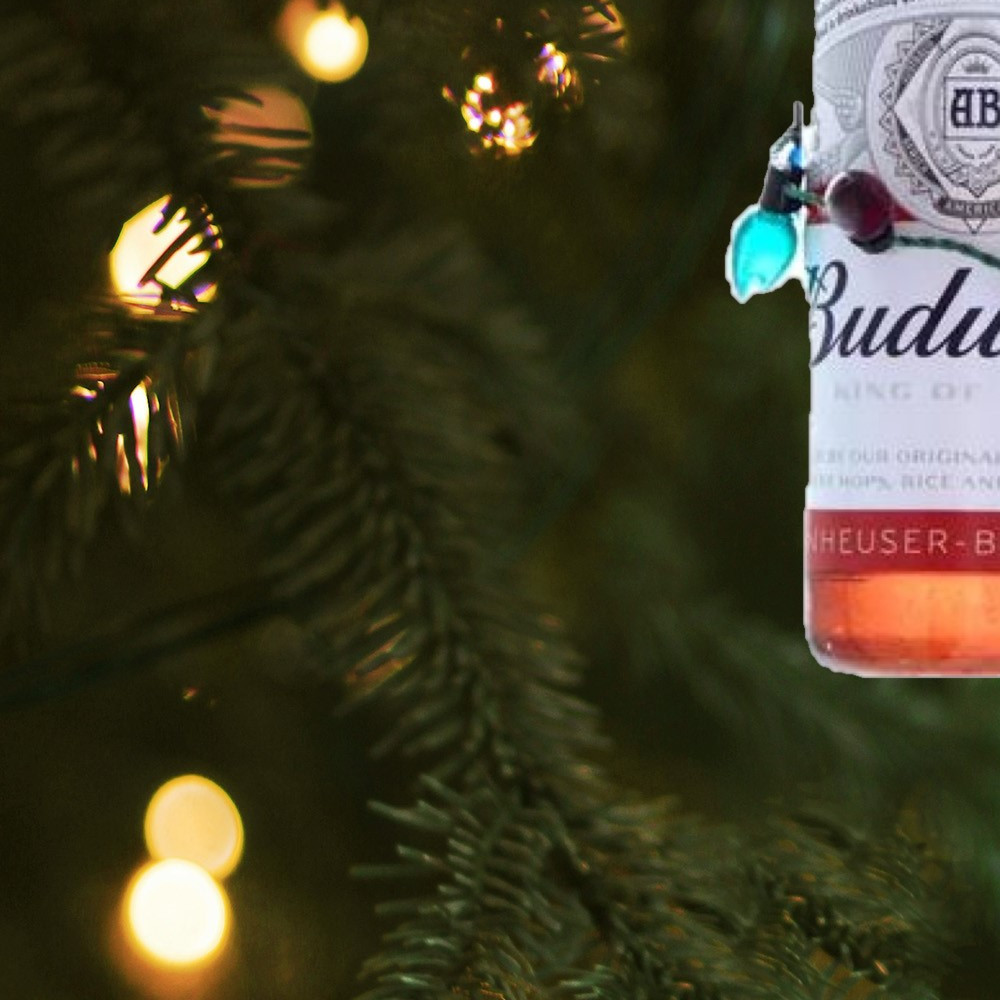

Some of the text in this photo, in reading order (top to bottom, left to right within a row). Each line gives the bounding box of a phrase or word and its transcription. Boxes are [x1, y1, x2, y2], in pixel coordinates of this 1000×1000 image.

[834, 381, 912, 401] KING
[931, 381, 983, 402] OF
[901, 475, 958, 491] RICE
